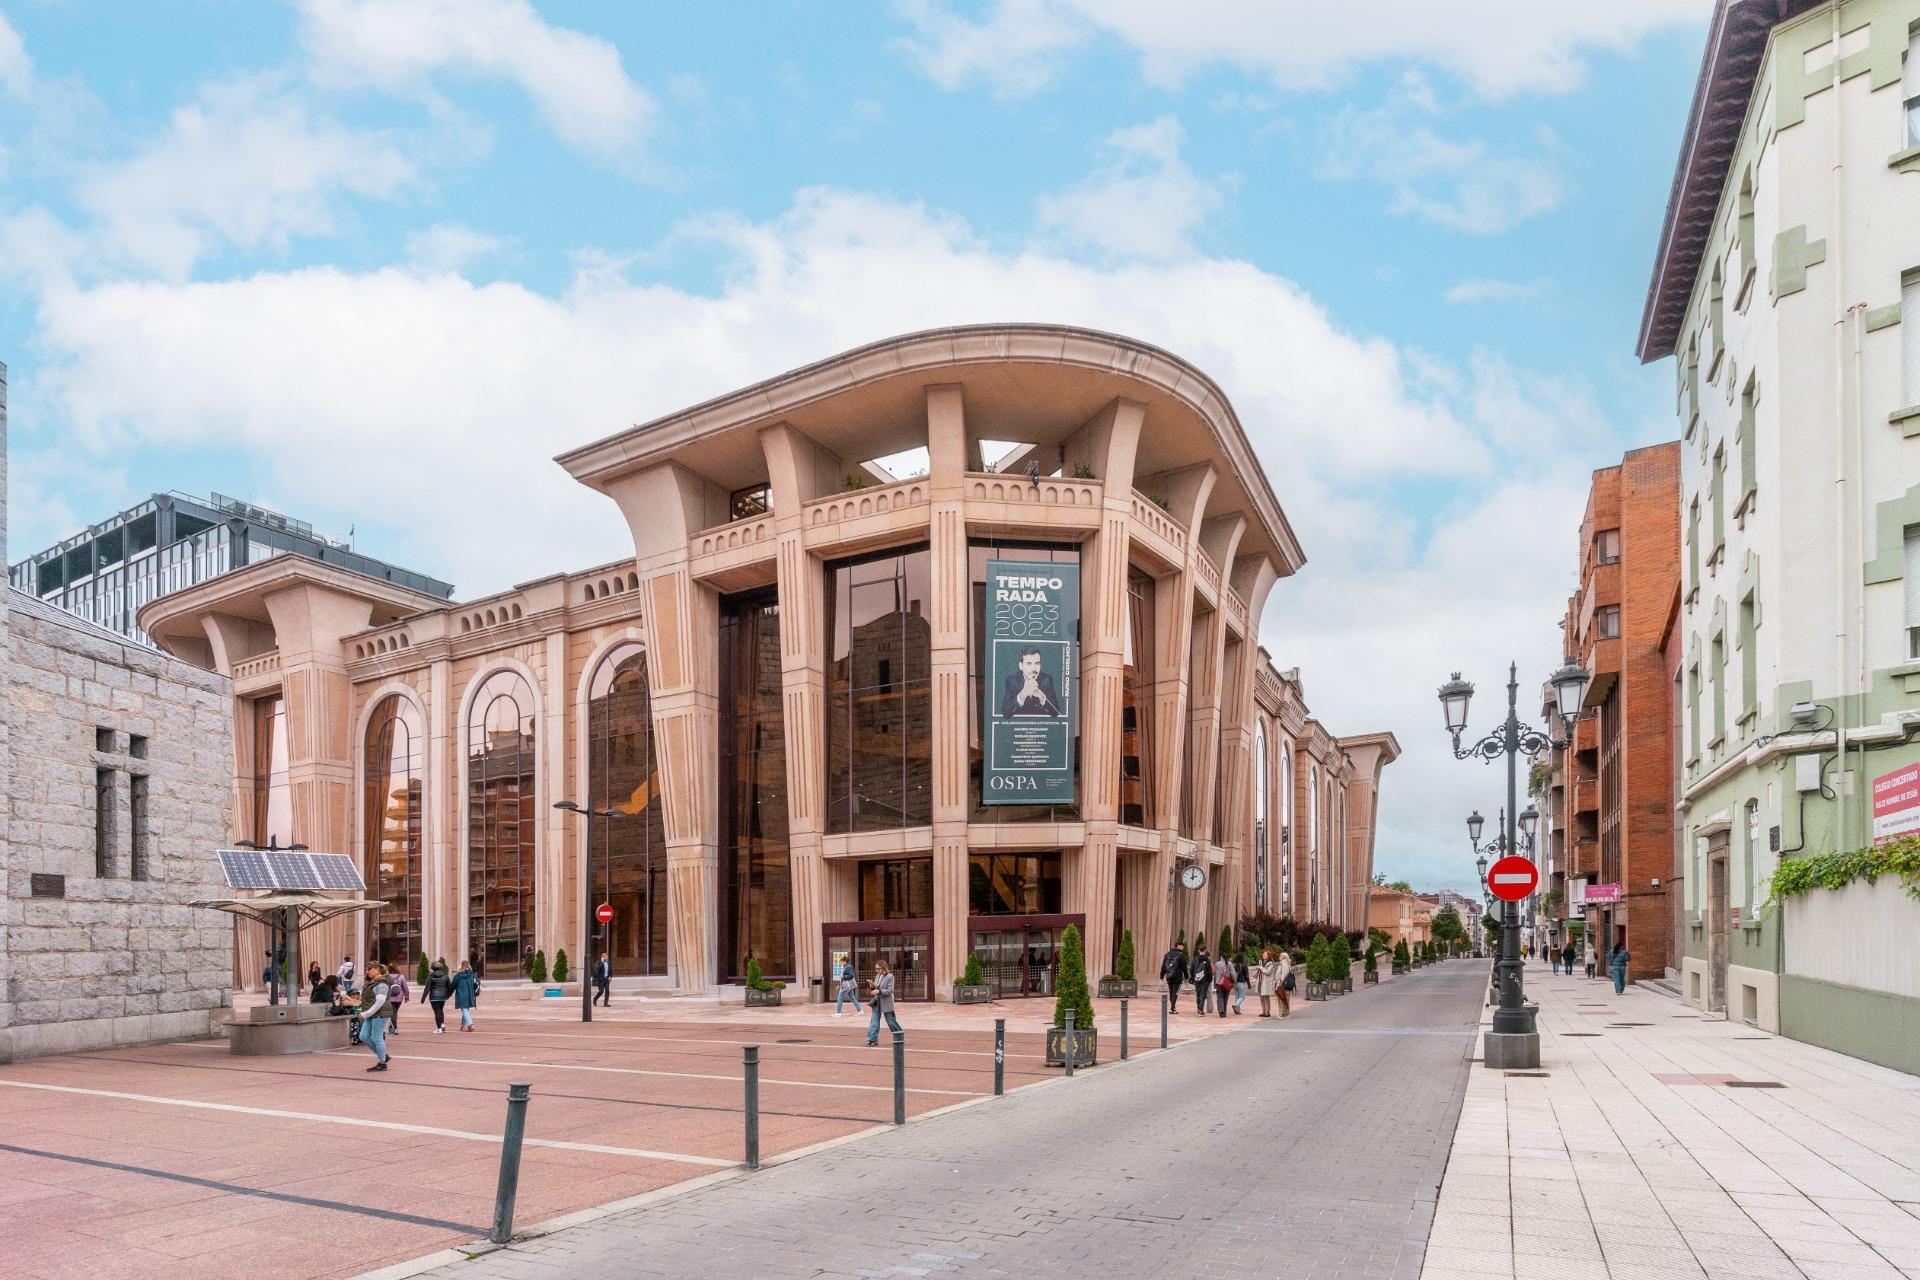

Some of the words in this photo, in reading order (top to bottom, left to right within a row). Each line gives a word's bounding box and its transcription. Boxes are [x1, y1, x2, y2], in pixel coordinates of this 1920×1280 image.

[995, 576, 1063, 590] TEMPO
[996, 589, 1048, 602] RADA
[995, 603, 1059, 620] 2023
[995, 620, 1058, 636] 2024
[990, 776, 1038, 790] OSPA
